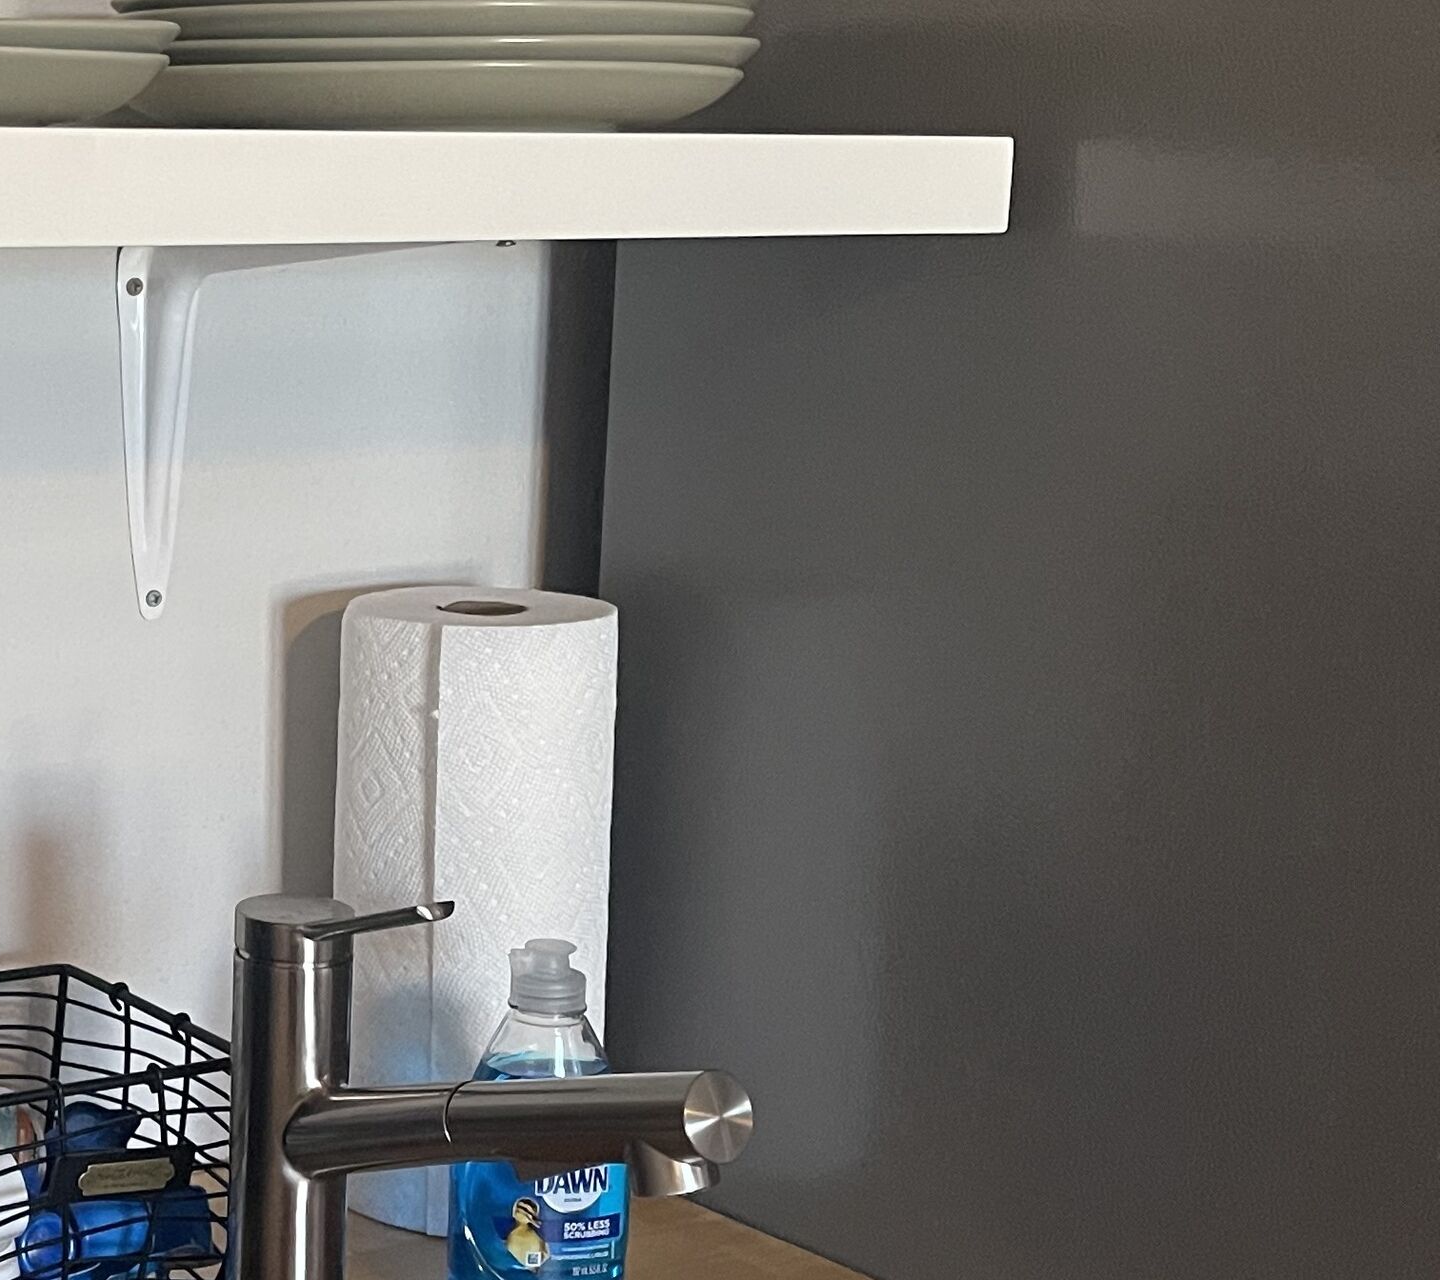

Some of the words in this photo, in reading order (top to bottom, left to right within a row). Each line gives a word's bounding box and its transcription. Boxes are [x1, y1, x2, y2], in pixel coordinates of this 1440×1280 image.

[536, 1166, 608, 1194] DAWN
[564, 1222, 586, 1232] 50%
[588, 1219, 610, 1230] LESS
